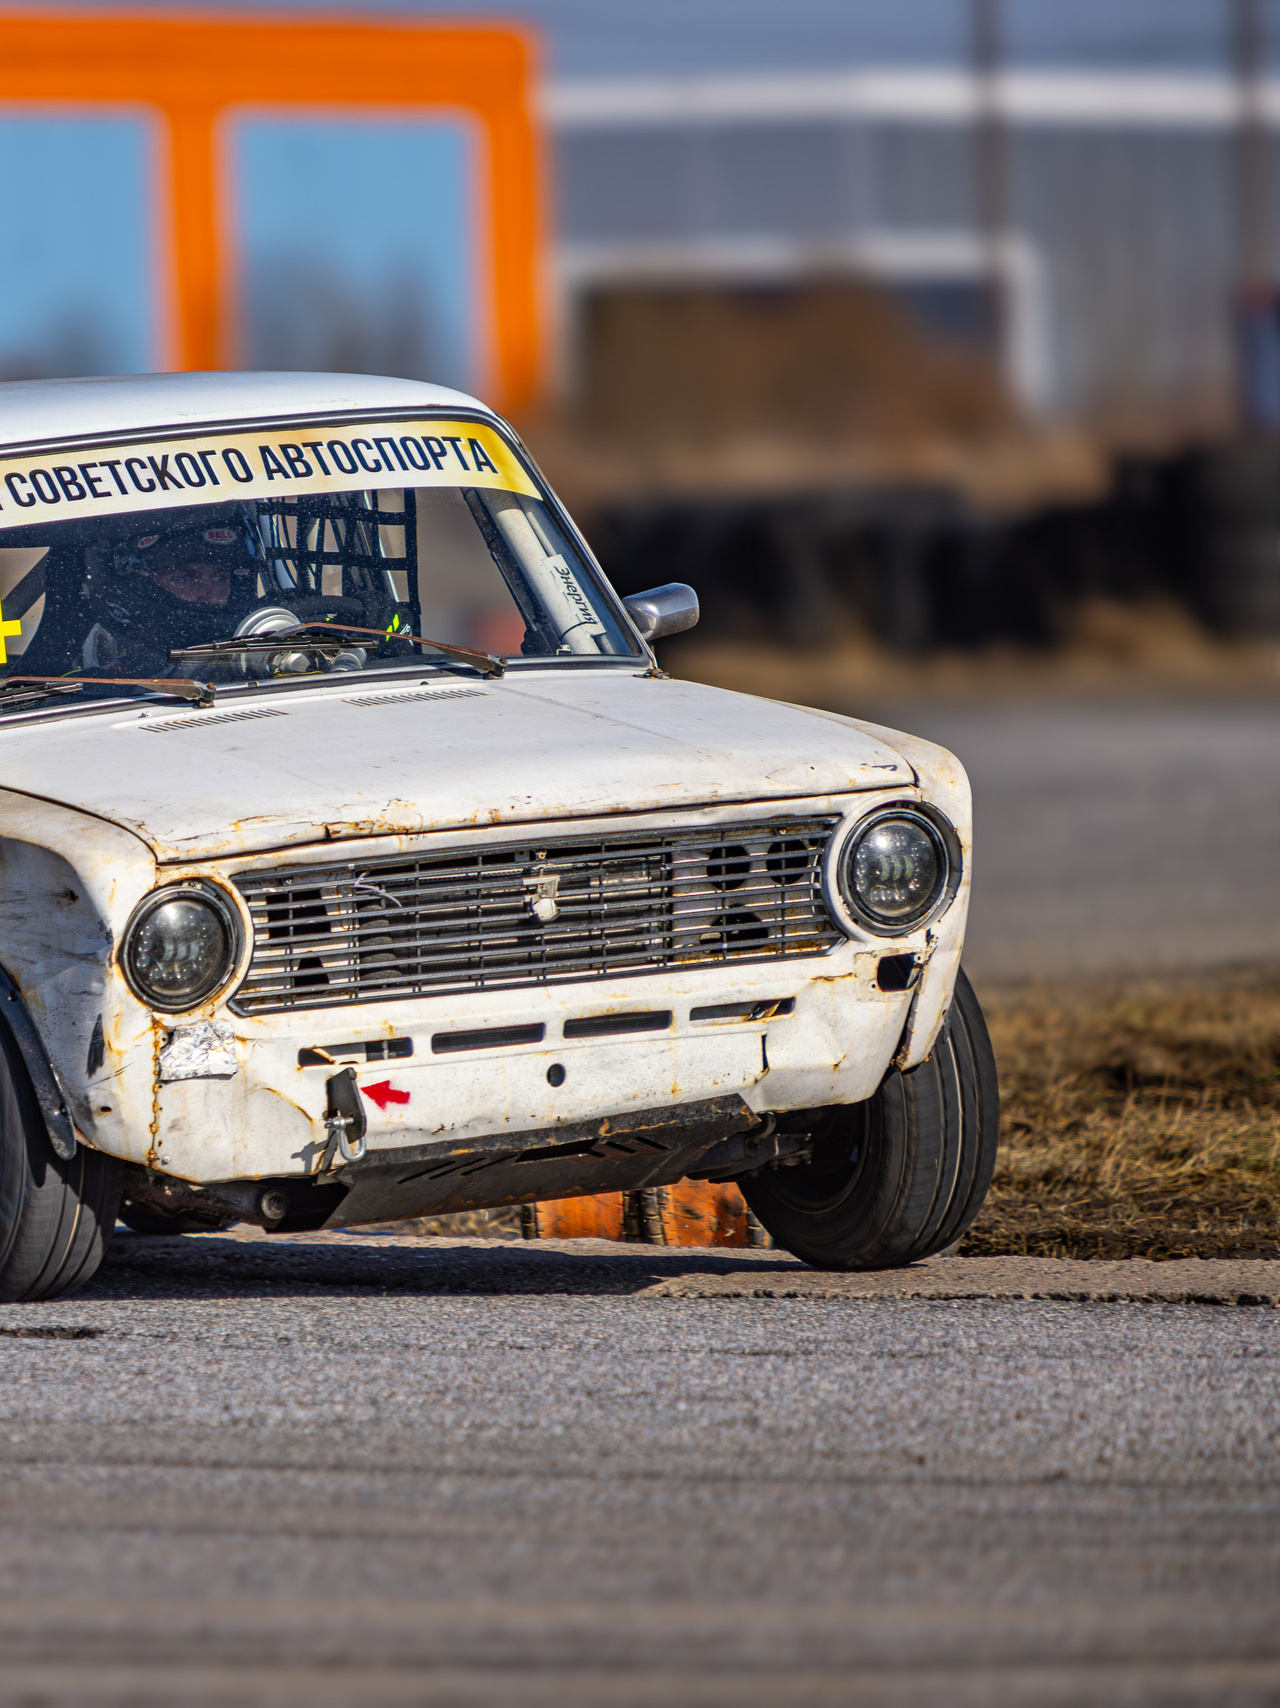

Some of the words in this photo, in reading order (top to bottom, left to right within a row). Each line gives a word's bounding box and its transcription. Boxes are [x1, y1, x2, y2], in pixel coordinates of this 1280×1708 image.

[4, 447, 254, 508] СОВЕТСКОГО
[258, 435, 500, 481] АВТОСПОРТА
[207, 530, 234, 540] BELL
[554, 565, 598, 625] Энергия
